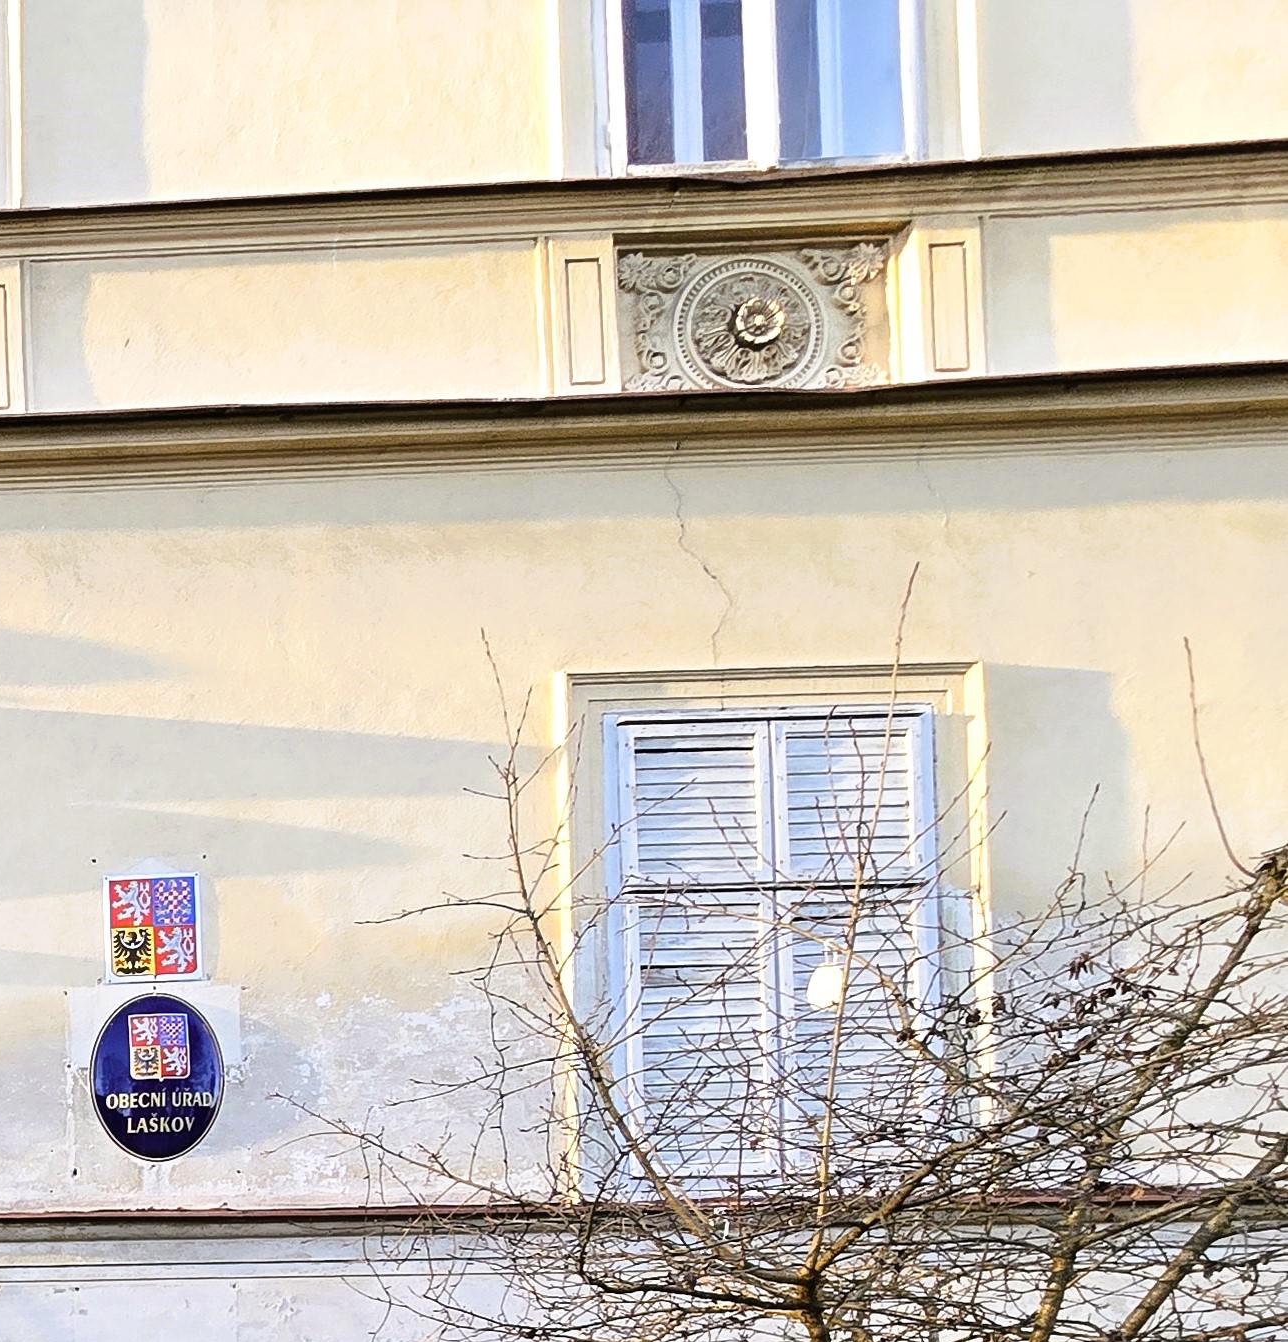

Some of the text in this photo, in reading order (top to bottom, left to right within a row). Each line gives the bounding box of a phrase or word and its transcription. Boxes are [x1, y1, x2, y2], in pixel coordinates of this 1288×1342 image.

[105, 1087, 213, 1109] OBECNÍ ÚŘAD
[126, 1112, 195, 1134] LAŠKOV
